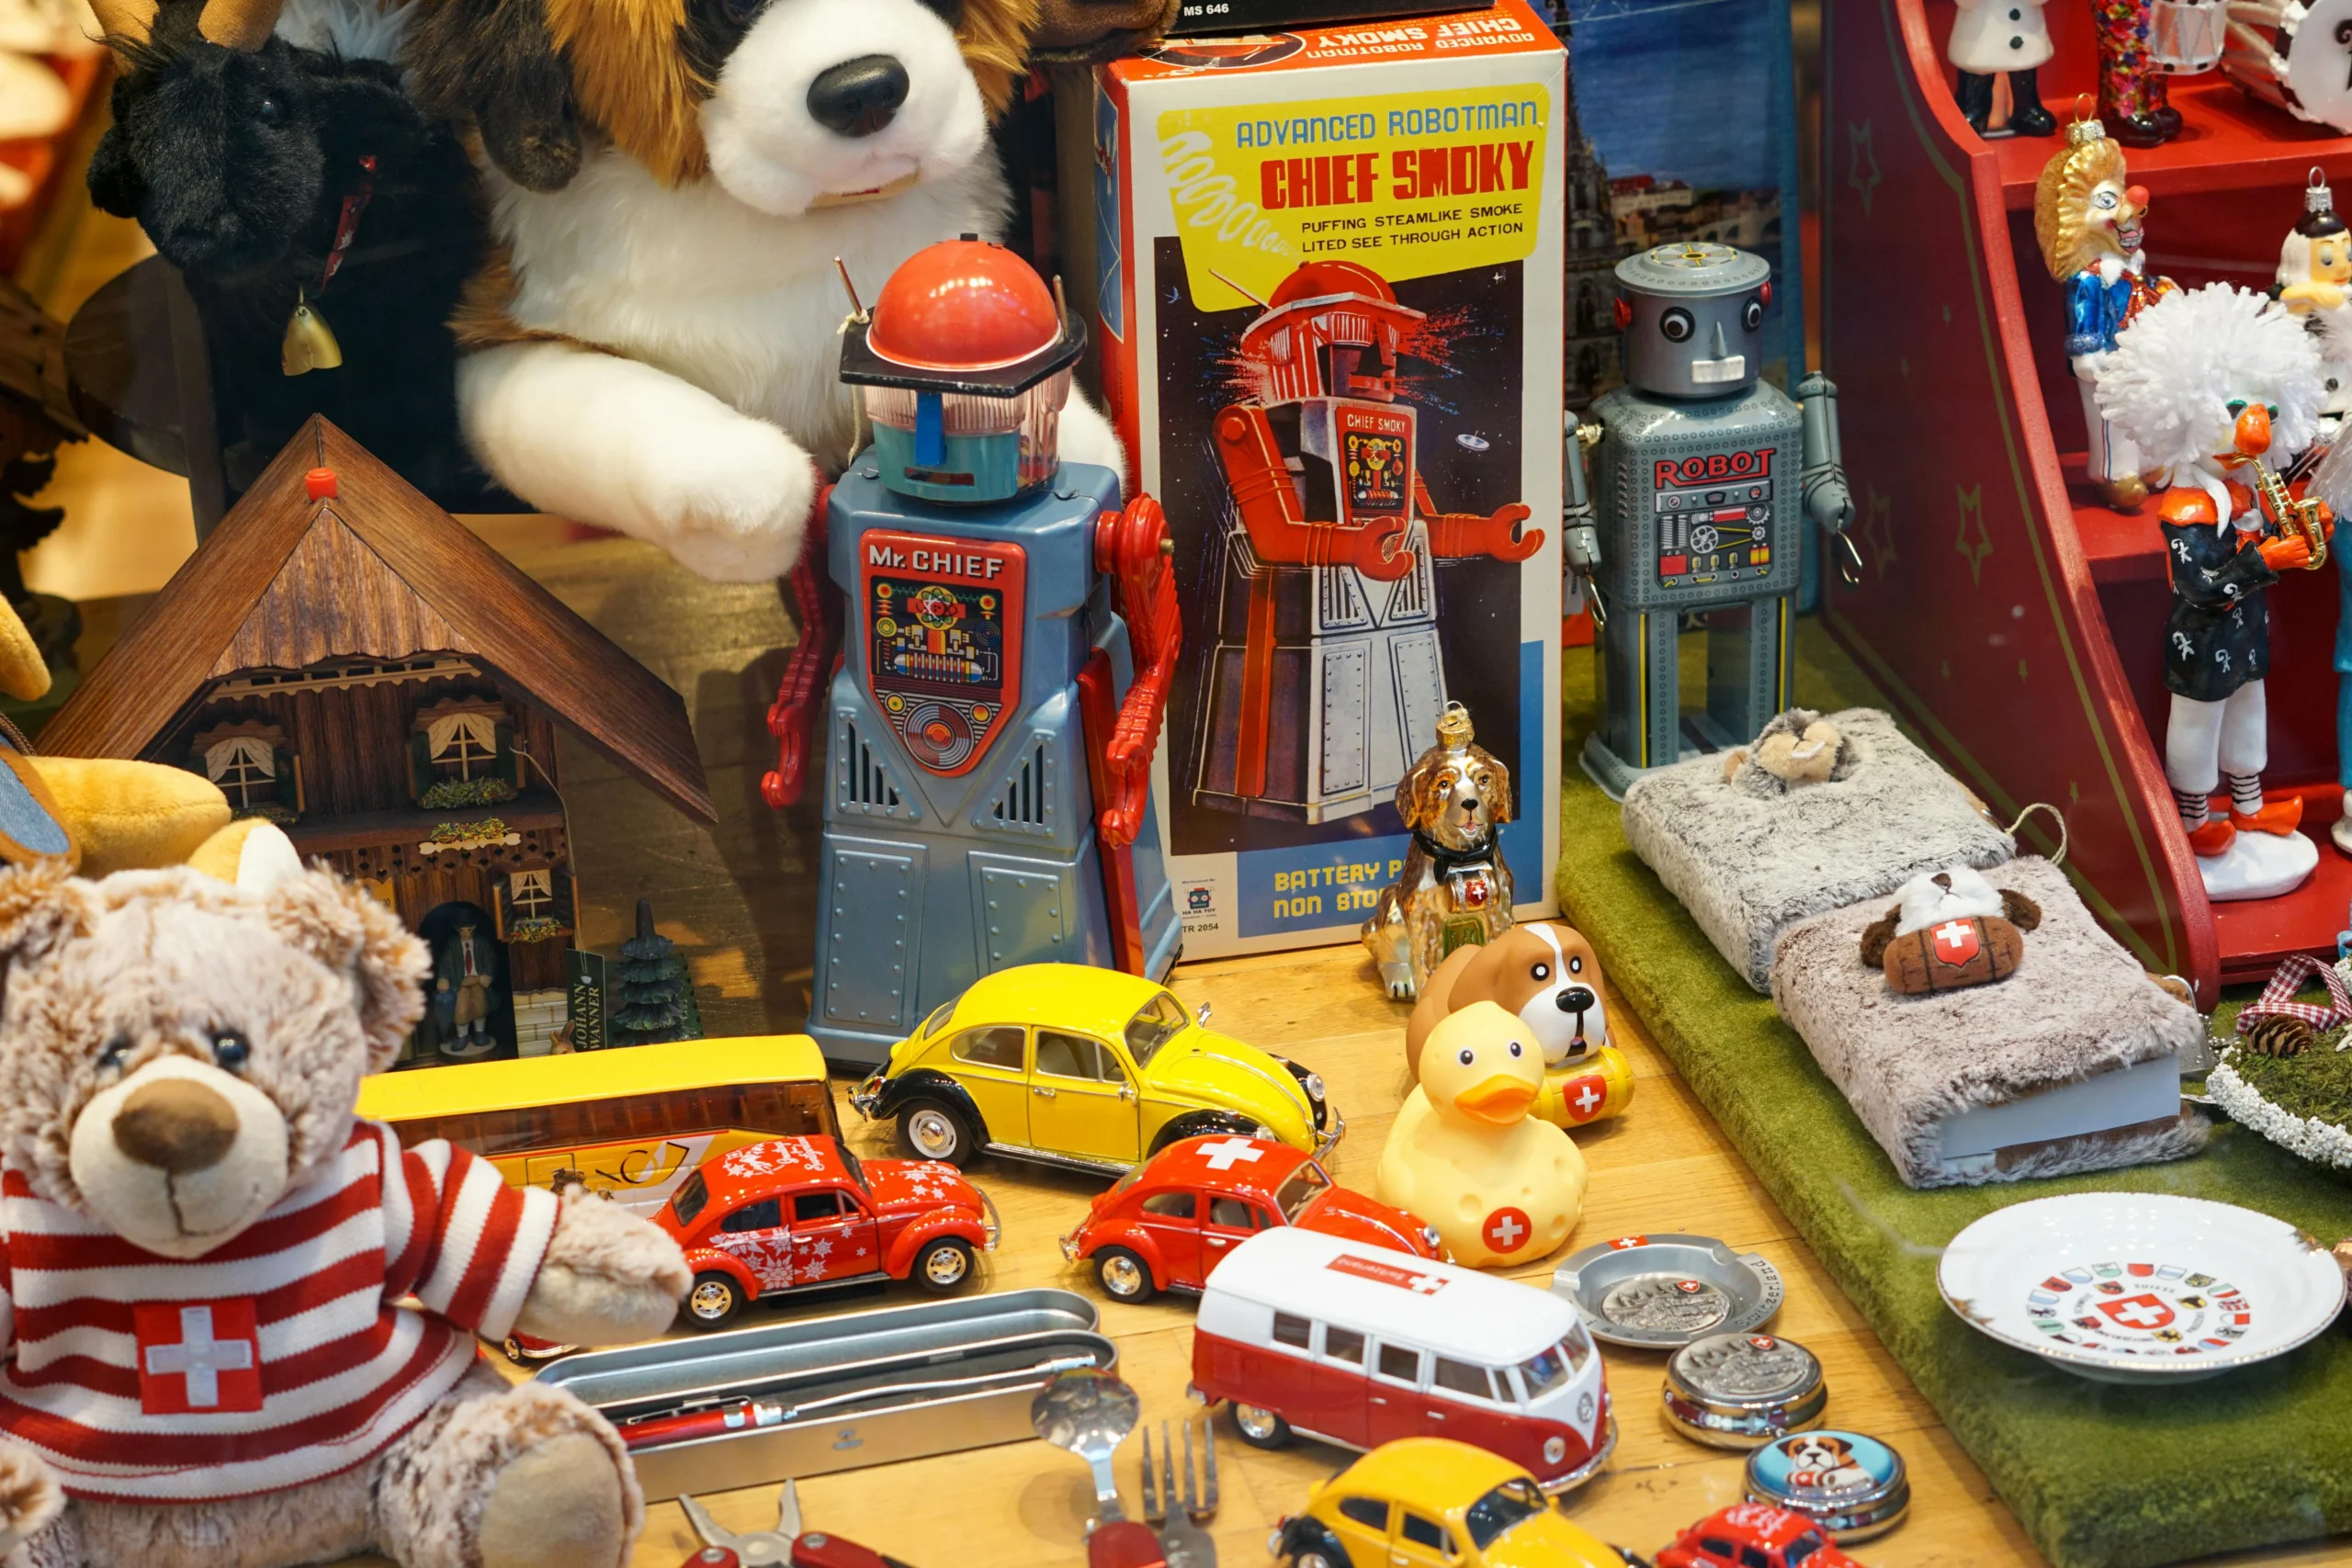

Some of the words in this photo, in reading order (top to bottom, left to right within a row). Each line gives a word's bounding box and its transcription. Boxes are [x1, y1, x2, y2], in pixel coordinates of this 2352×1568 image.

[1183, 6, 1203, 17] MS
[1206, 4, 1229, 15] 646
[1318, 27, 1429, 48] SMOKY
[1434, 32, 1535, 49] ADVANCED
[1437, 17, 1522, 38] CHIEF
[1306, 42, 1425, 59] ROBOTMAN
[1237, 113, 1376, 148] ADVANCED
[1387, 101, 1537, 137] ROBOTMAN
[1261, 152, 1380, 210] CHIEF
[1392, 141, 1534, 200] SMOKY
[1302, 218, 1366, 233] PUFFING
[1374, 209, 1462, 228] STEAMLIKE
[1470, 203, 1522, 219] SMOKE
[1302, 238, 1347, 253] LITED
[1351, 236, 1383, 249] SEE
[1389, 229, 1461, 246] THROUGH
[1467, 221, 1523, 239] ACTION
[1347, 413, 1374, 429] CHIEF
[1378, 418, 1406, 433] SMOKY
[1655, 448, 1777, 489] ROBOT
[869, 545, 907, 569] Mr.
[912, 550, 1004, 580] CHIEF
[1274, 862, 1380, 891] BATTERY
[1273, 896, 1322, 919] NON
[1182, 925, 1194, 933] TR
[1197, 922, 1219, 932] 2054
[574, 983, 588, 1049] JOHANN
[588, 987, 601, 1049] WANNER
[1735, 1260, 1780, 1325] Switzerland
